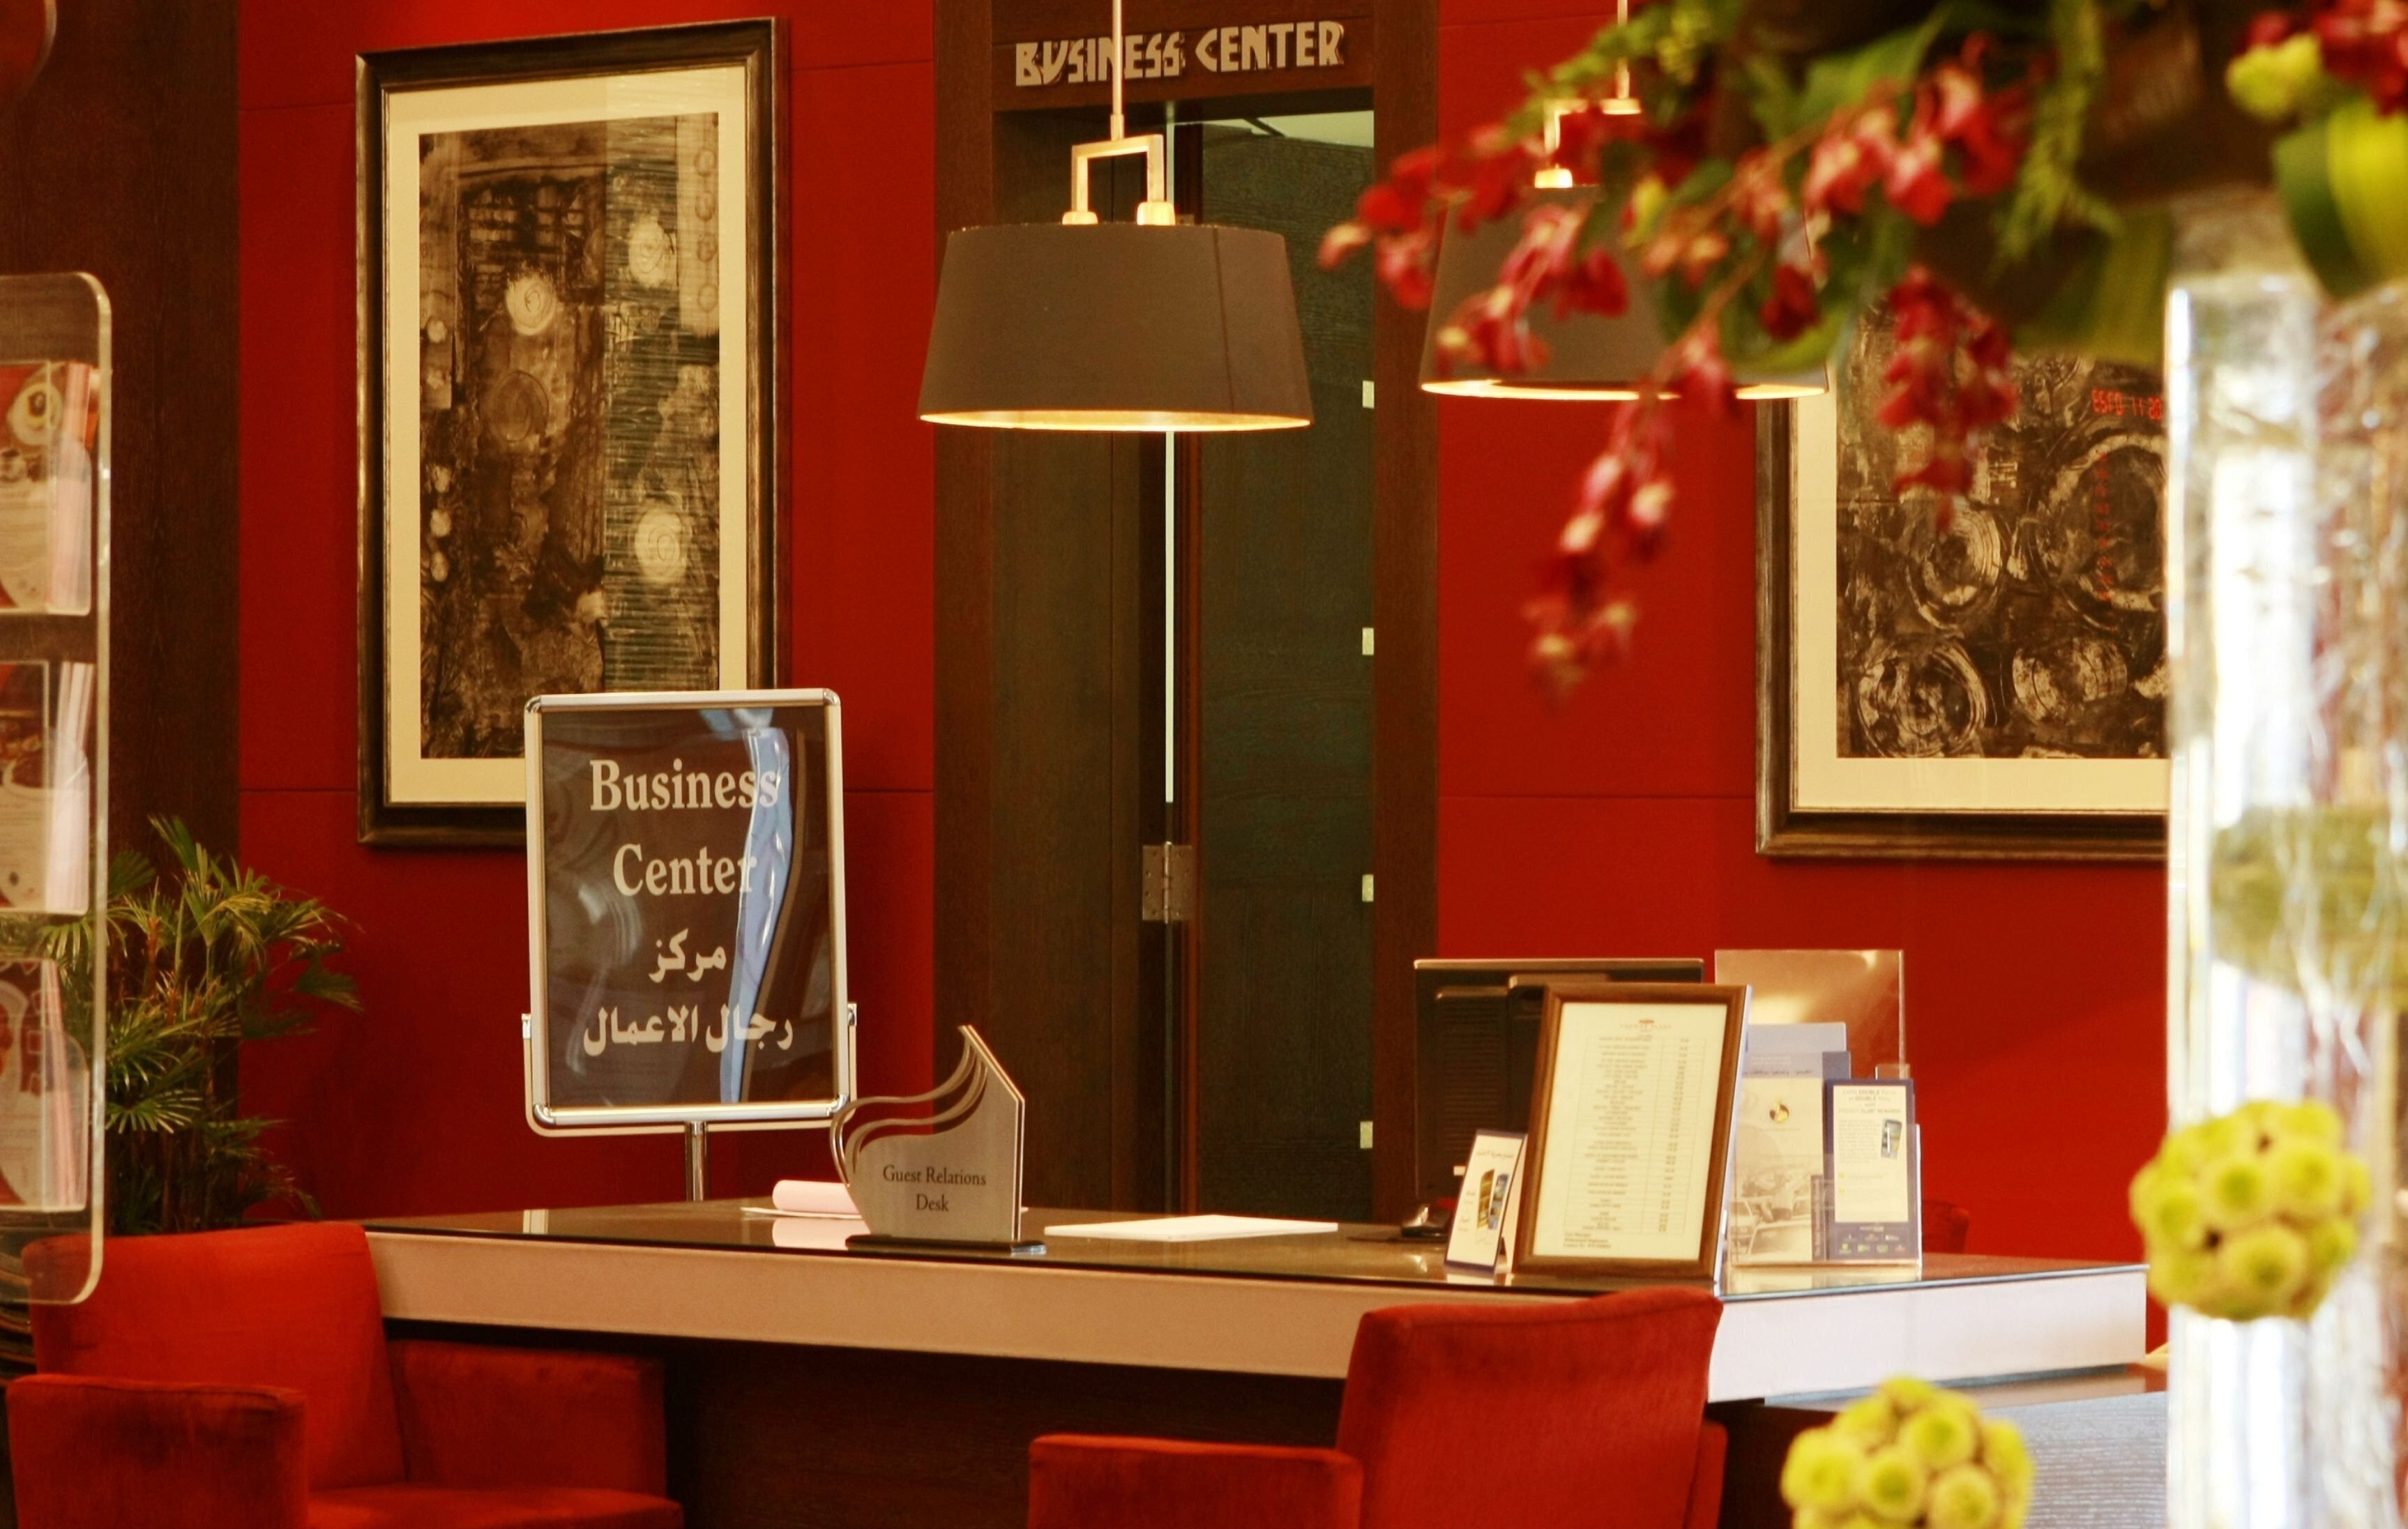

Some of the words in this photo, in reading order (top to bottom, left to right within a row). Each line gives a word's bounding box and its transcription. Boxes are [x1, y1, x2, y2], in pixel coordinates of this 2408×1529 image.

[1016, 33, 1182, 86] BUSINESS
[1195, 21, 1344, 73] CENTER
[589, 758, 779, 812] Business
[613, 844, 757, 896] Center
[648, 927, 727, 983] مركز
[583, 1004, 698, 1057] الاعمال
[706, 1003, 794, 1053] رجال
[882, 1164, 921, 1182] Guest
[925, 1166, 987, 1186] Relations
[915, 1193, 949, 1212] Desk
